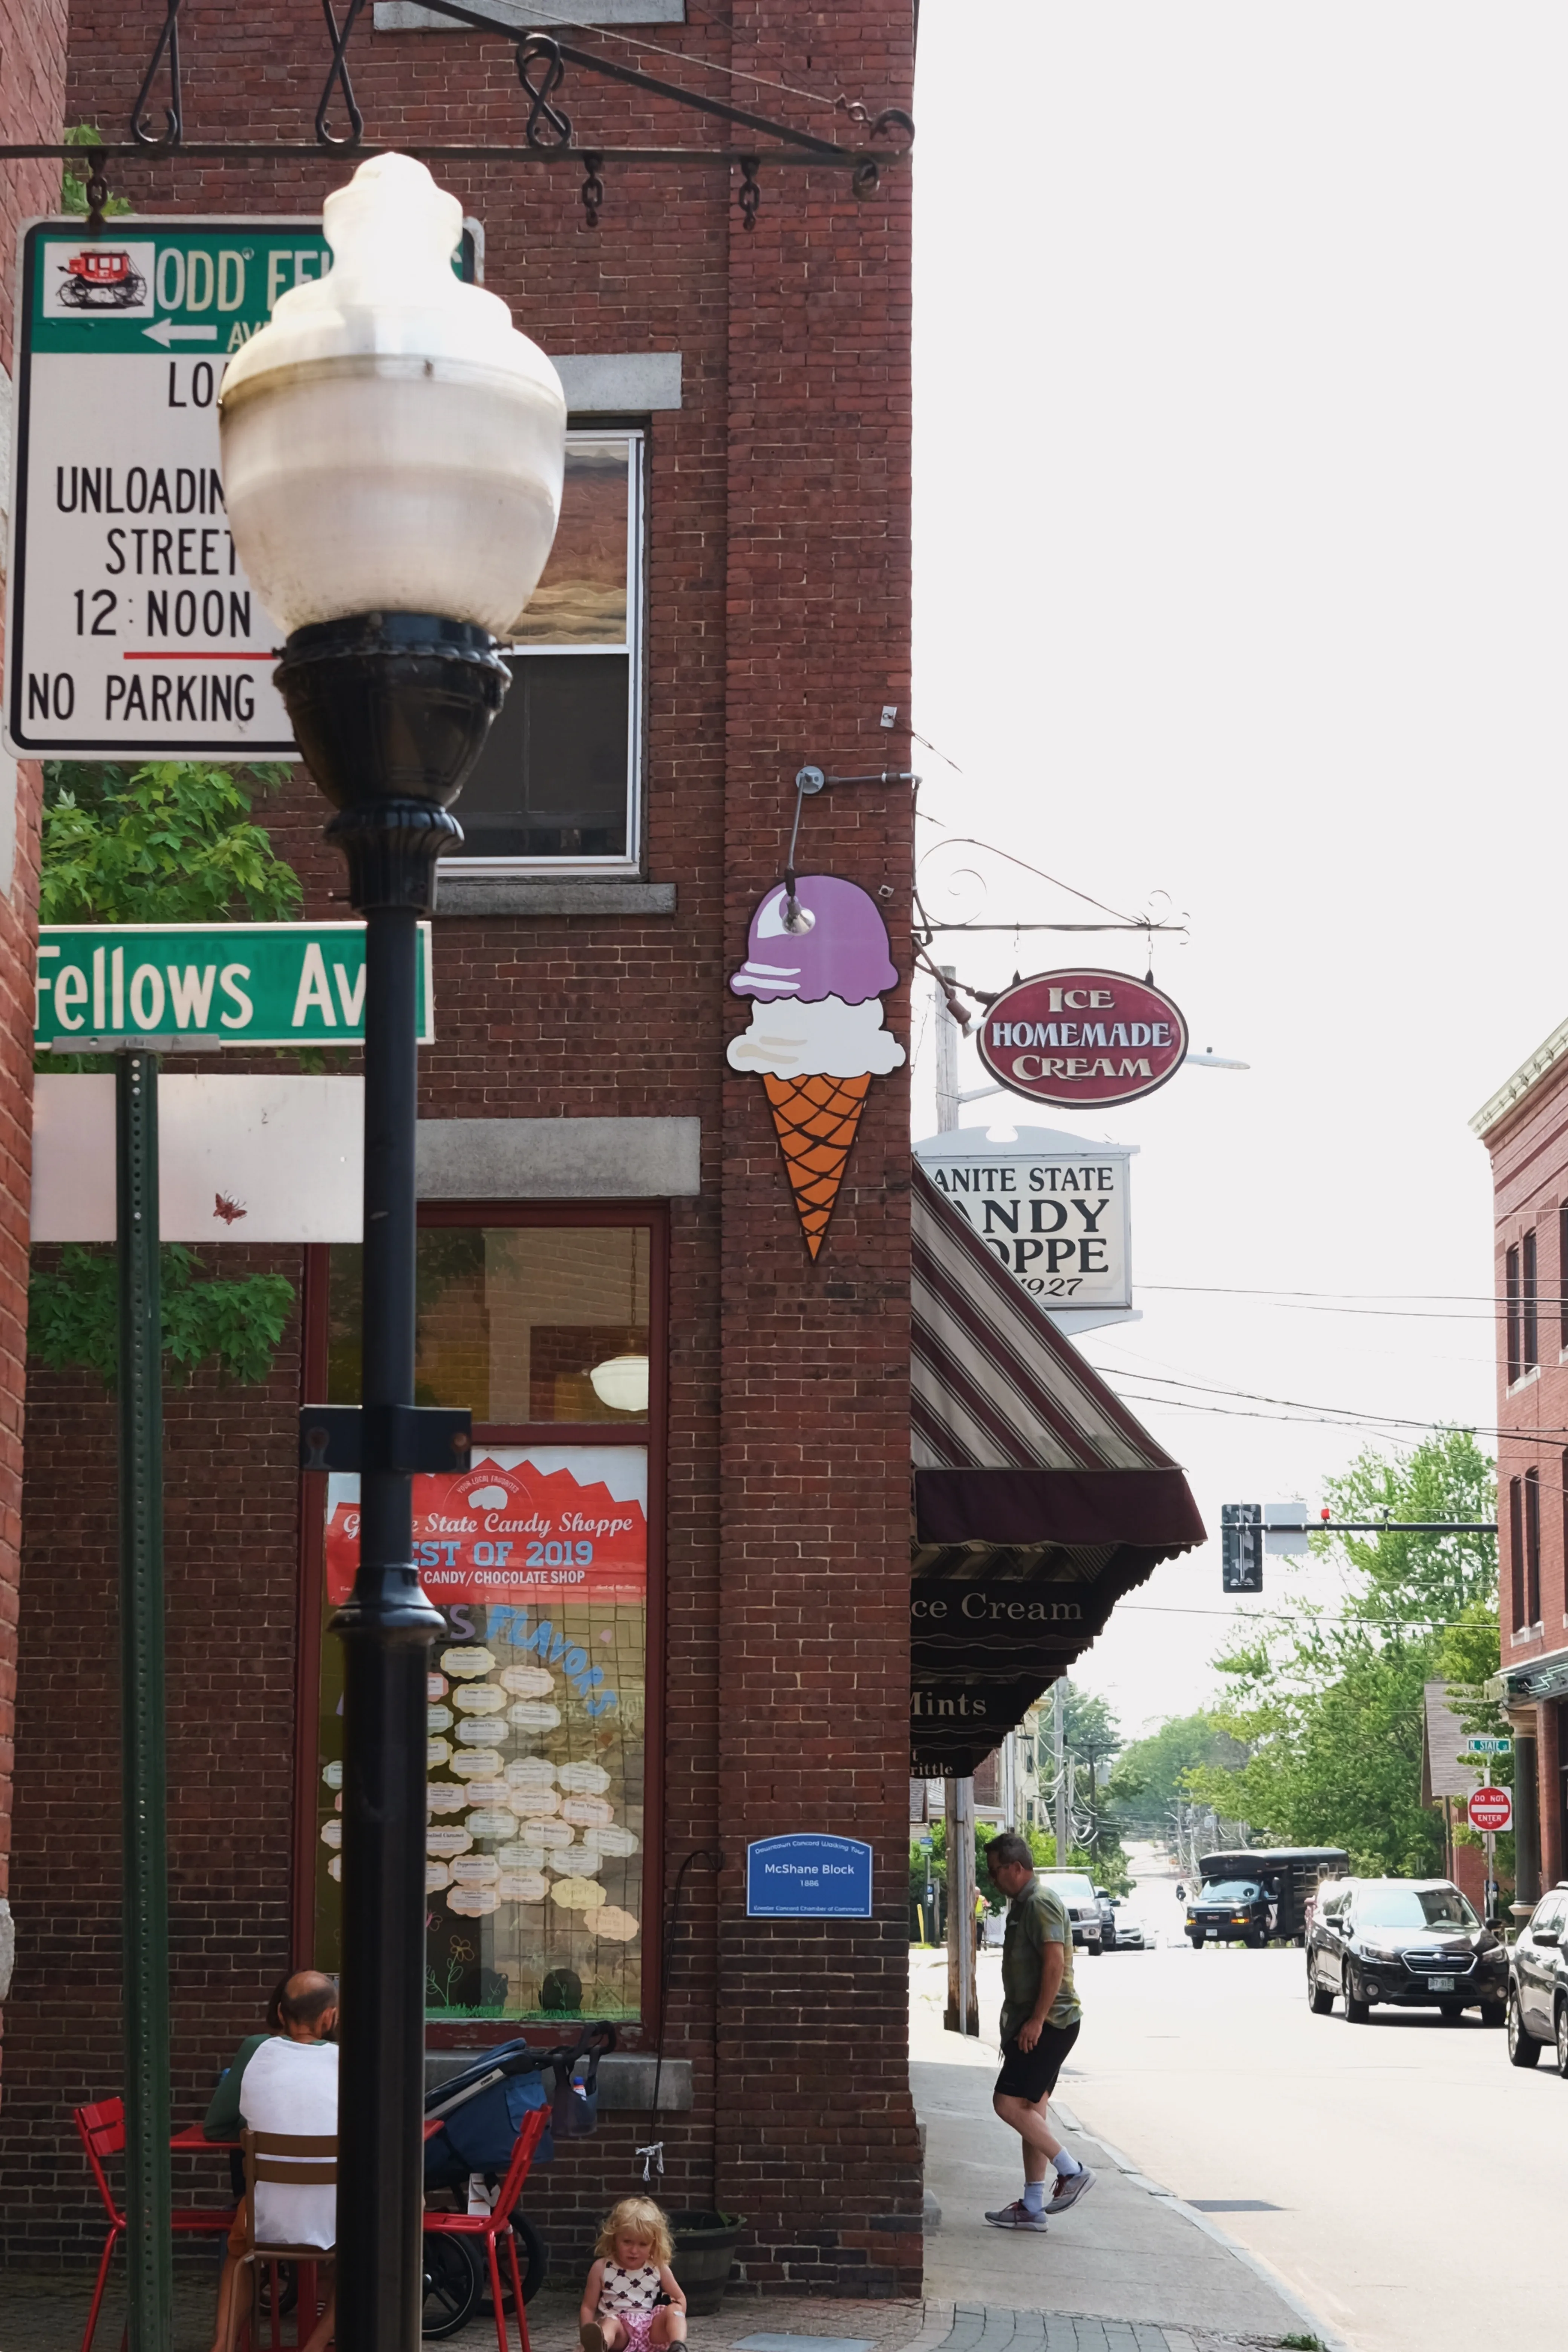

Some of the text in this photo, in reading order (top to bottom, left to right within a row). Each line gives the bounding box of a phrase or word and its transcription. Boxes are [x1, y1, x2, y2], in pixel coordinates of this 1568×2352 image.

[156, 248, 245, 311] ODD
[168, 361, 229, 407] LO
[56, 466, 227, 514] UNLOADIN
[148, 590, 251, 638] NOON
[28, 672, 255, 721] NO PARKING
[33, 942, 366, 1030] Fellows Av
[992, 1022, 1173, 1048] HOMEMADE
[1012, 1055, 1154, 1081] CREAM
[934, 1167, 1114, 1192] ANITE STATE
[953, 1199, 1110, 1234] NDY
[425, 1513, 479, 1533] State
[484, 1512, 553, 1538] Candy
[558, 1511, 634, 1537] Shoppe
[473, 1541, 513, 1566] OF
[526, 1540, 593, 1566] 2019
[424, 1570, 585, 1587] CANDY/CHOCOLATE SHOP
[911, 1592, 1083, 1620] ce Cream
[484, 1604, 617, 1718] FLAVORS
[1480, 1740, 1501, 1750] STATE
[910, 1762, 953, 1776] rittle
[755, 1842, 791, 1854] Downtown
[821, 1841, 849, 1851] Walking
[850, 1846, 865, 1855] Tour
[765, 1864, 855, 1874] McShane Block
